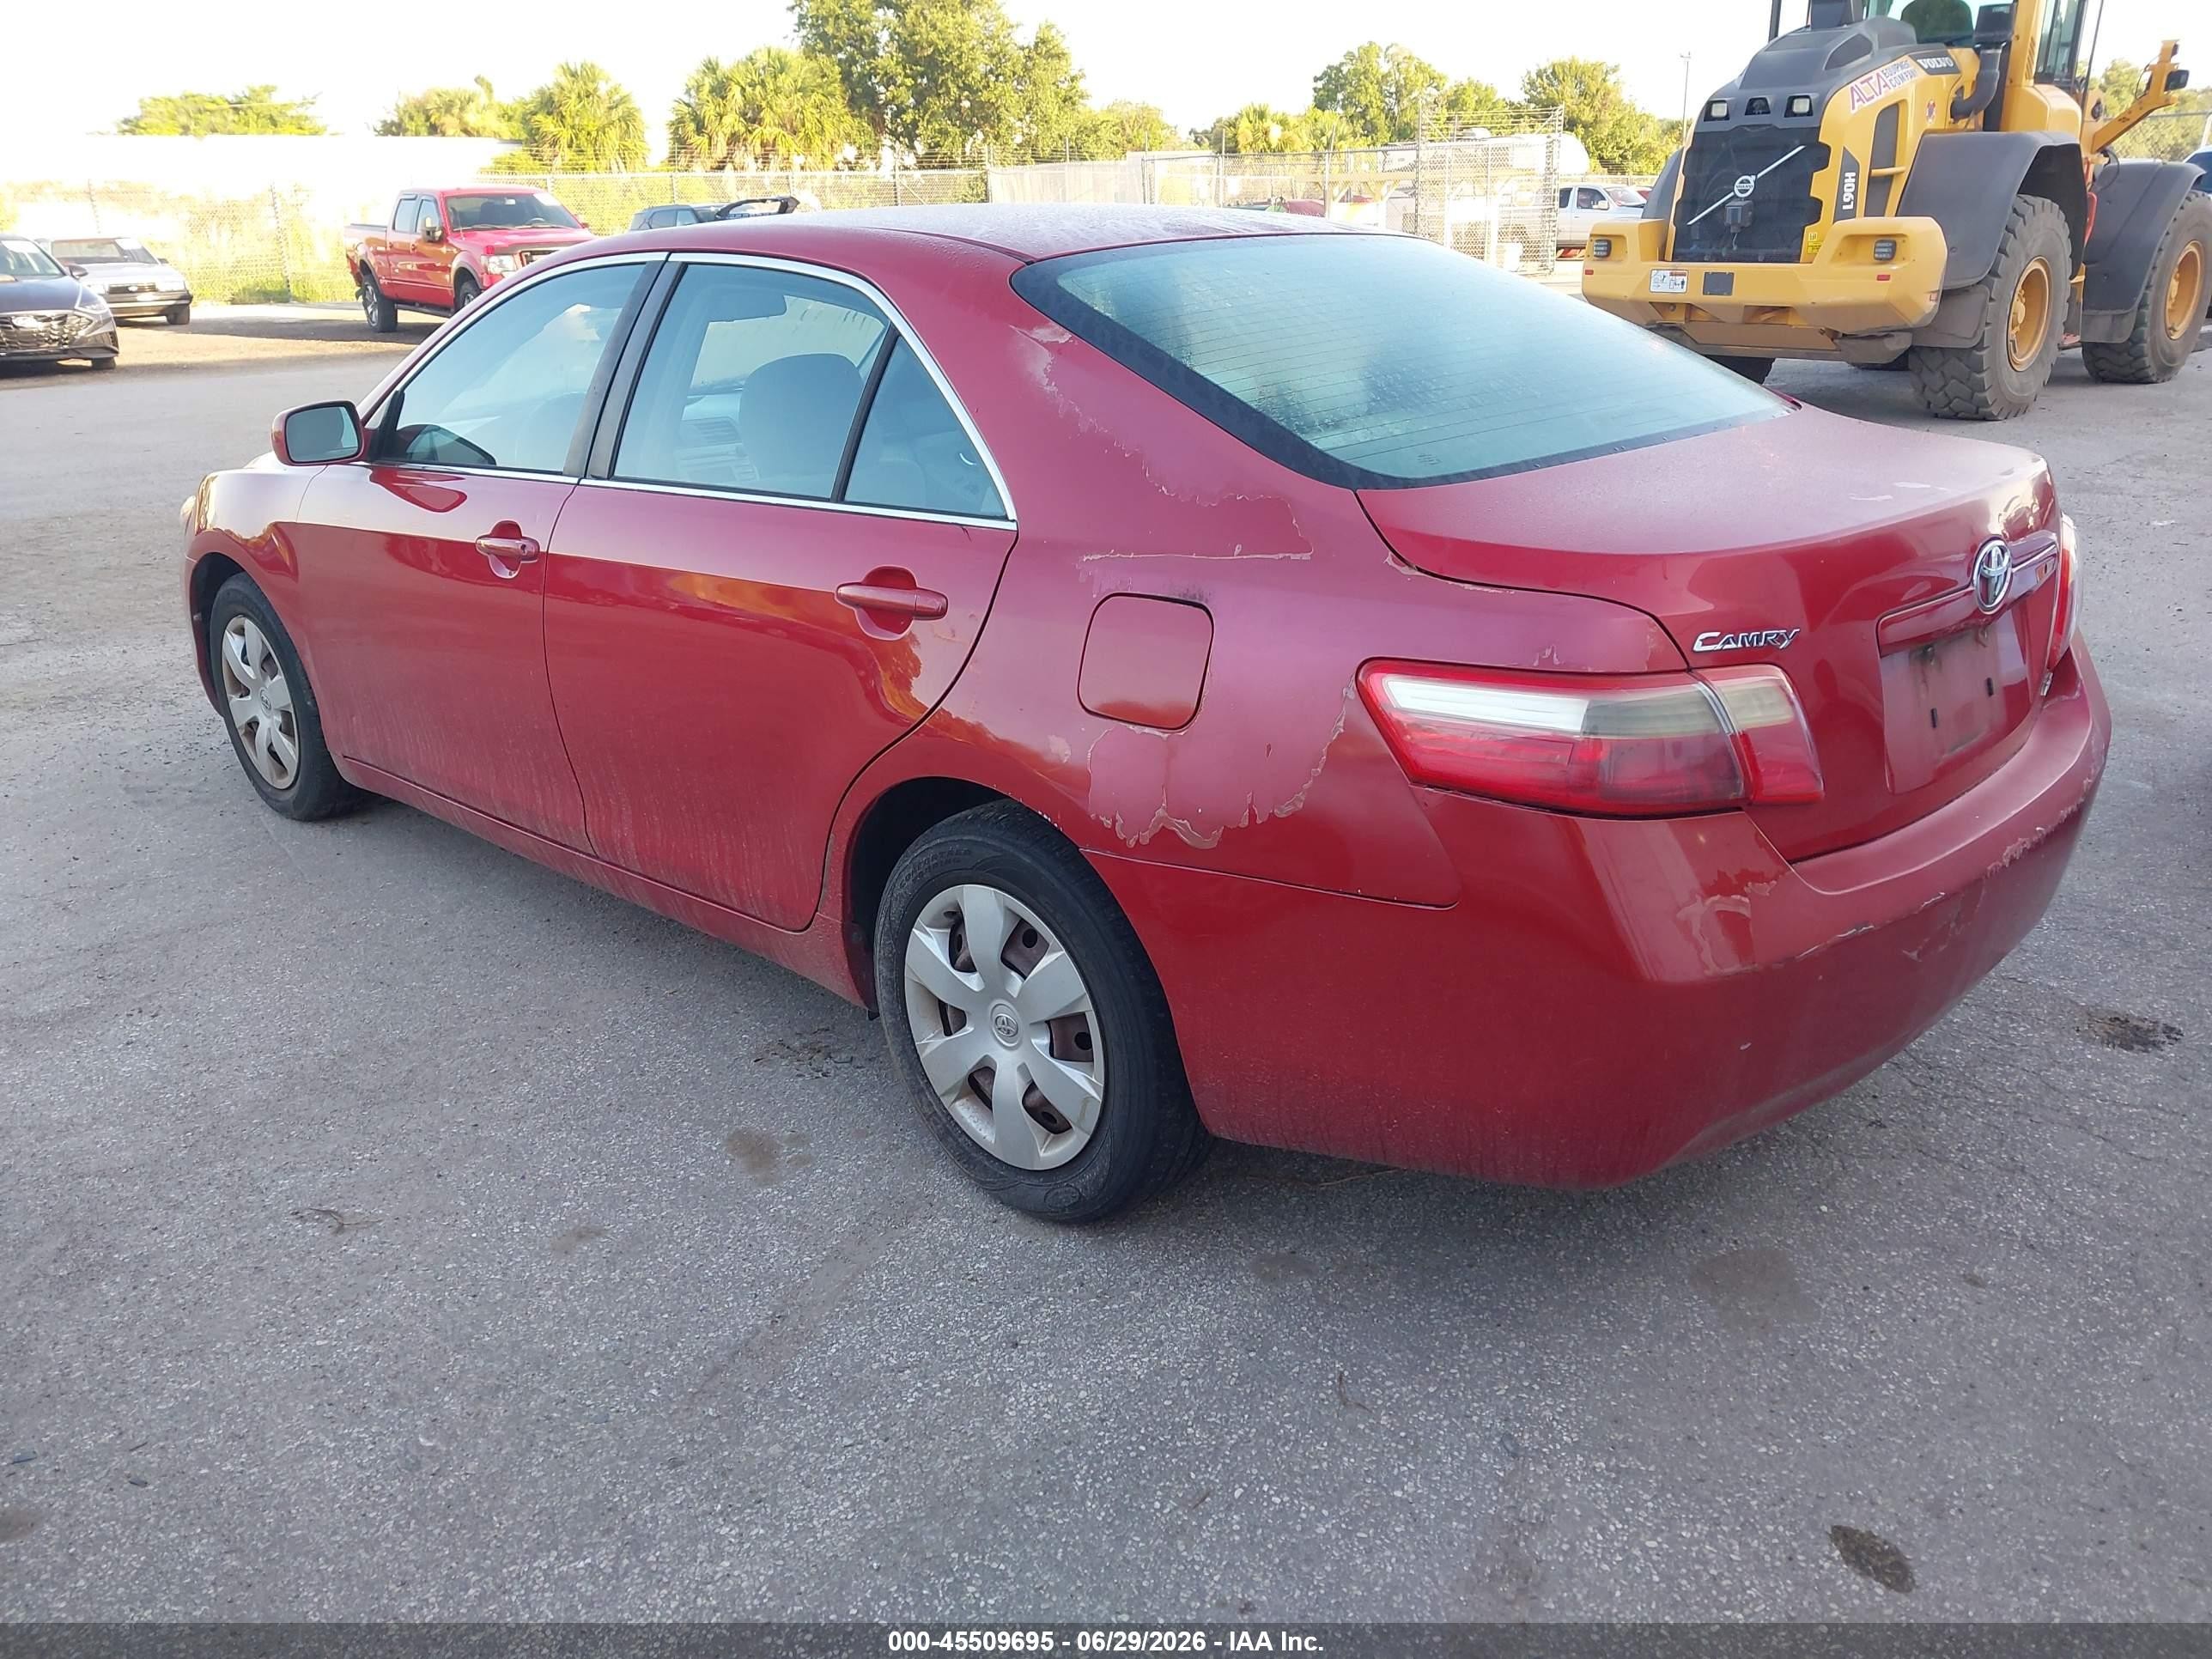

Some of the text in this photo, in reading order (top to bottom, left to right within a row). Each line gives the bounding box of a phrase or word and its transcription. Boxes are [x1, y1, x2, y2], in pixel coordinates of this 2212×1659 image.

[1917, 57, 1954, 69] VOLVO
[1849, 71, 1891, 111] ALTA
[1842, 172, 1856, 210] L90H
[1692, 628, 1801, 653] CAMRY
